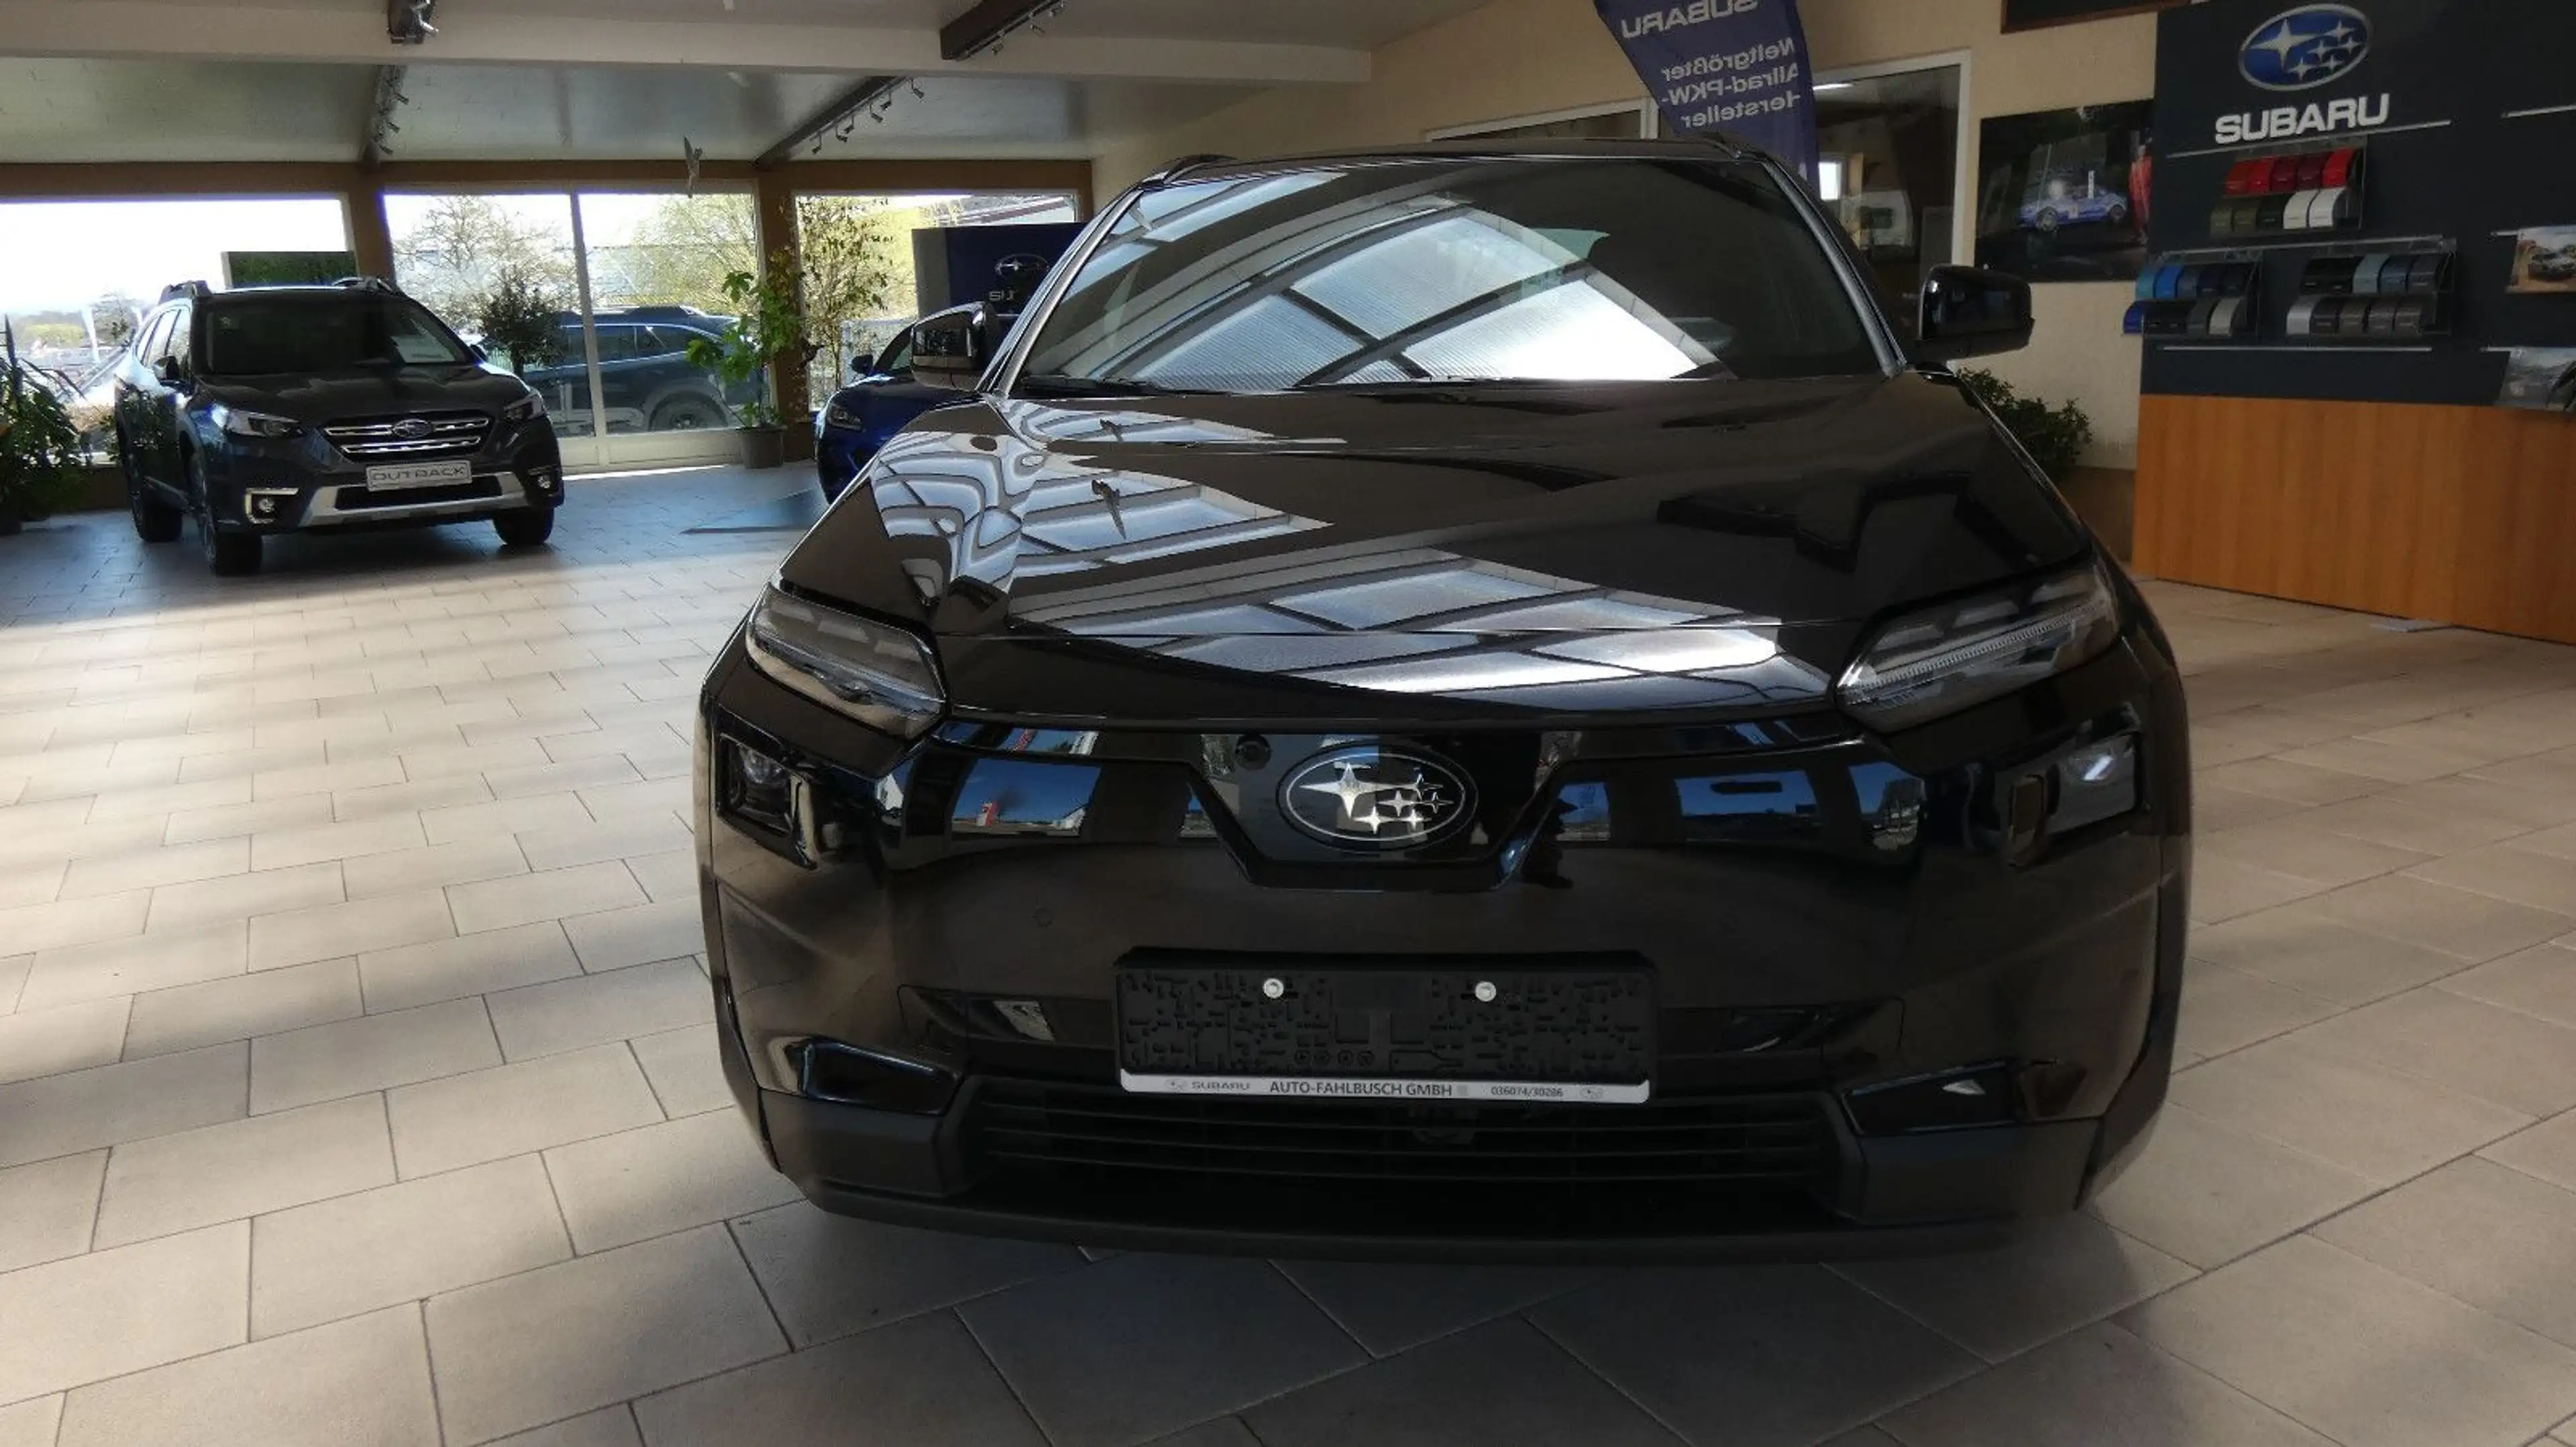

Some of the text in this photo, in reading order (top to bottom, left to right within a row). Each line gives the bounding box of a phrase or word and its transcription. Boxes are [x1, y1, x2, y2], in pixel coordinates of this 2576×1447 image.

[2215, 93, 2390, 144] SUBARU
[372, 466, 464, 481] OUTBACK
[1191, 1081, 1252, 1091] SUBARU
[1270, 1081, 1402, 1095] AUTO-FAHLBUSCH
[1405, 1083, 1452, 1097] GMBH
